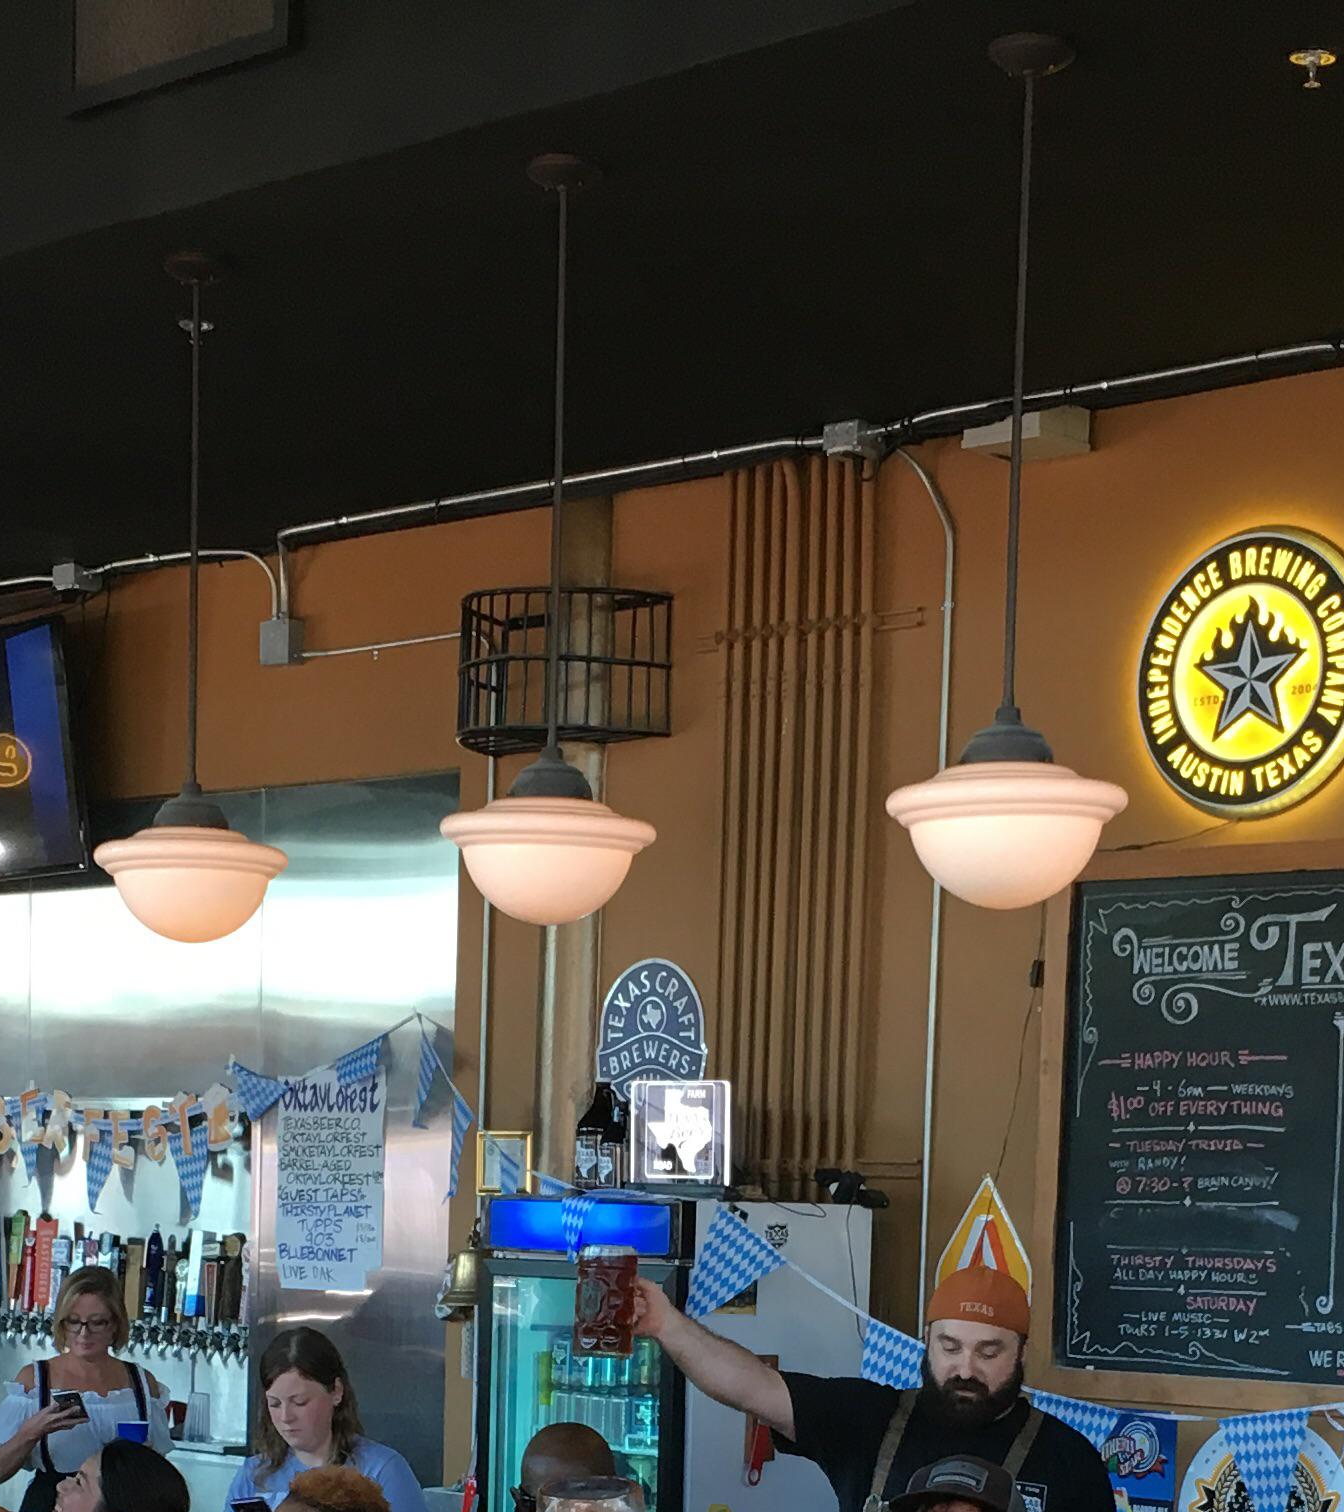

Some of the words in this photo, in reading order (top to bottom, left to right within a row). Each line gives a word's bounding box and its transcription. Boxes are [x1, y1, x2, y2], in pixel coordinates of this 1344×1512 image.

[1146, 562, 1224, 744] INDEPENDENCE
[1229, 546, 1327, 601] BREWING
[1167, 743, 1245, 797] AUSTIN
[1251, 729, 1324, 793] TEXAS
[608, 970, 651, 1042] TEXAS
[655, 970, 696, 1041] CRAFT
[608, 1041, 693, 1075] BREWERS
[1134, 1051, 1183, 1069] HAPPY
[1186, 1051, 1235, 1068] HOUR
[1230, 1083, 1295, 1099] WEEKDAYS
[1148, 1100, 1174, 1117] OFF
[1179, 1100, 1284, 1117] EVERYTHING
[764, 1229, 789, 1240] TEXAS
[282, 1263, 308, 1280] LIVE
[1111, 1254, 1175, 1269] THIRSTY
[1185, 1256, 1277, 1273] THURSDAYS
[1112, 1268, 1136, 1281] ALL
[1138, 1268, 1165, 1282] DAY
[1169, 1269, 1208, 1282] HAPPY
[1211, 1271, 1247, 1283] HOUR
[959, 1301, 995, 1318] TEXAS
[1185, 1296, 1257, 1316] SATURDAY
[1308, 1350, 1332, 1368] WE
